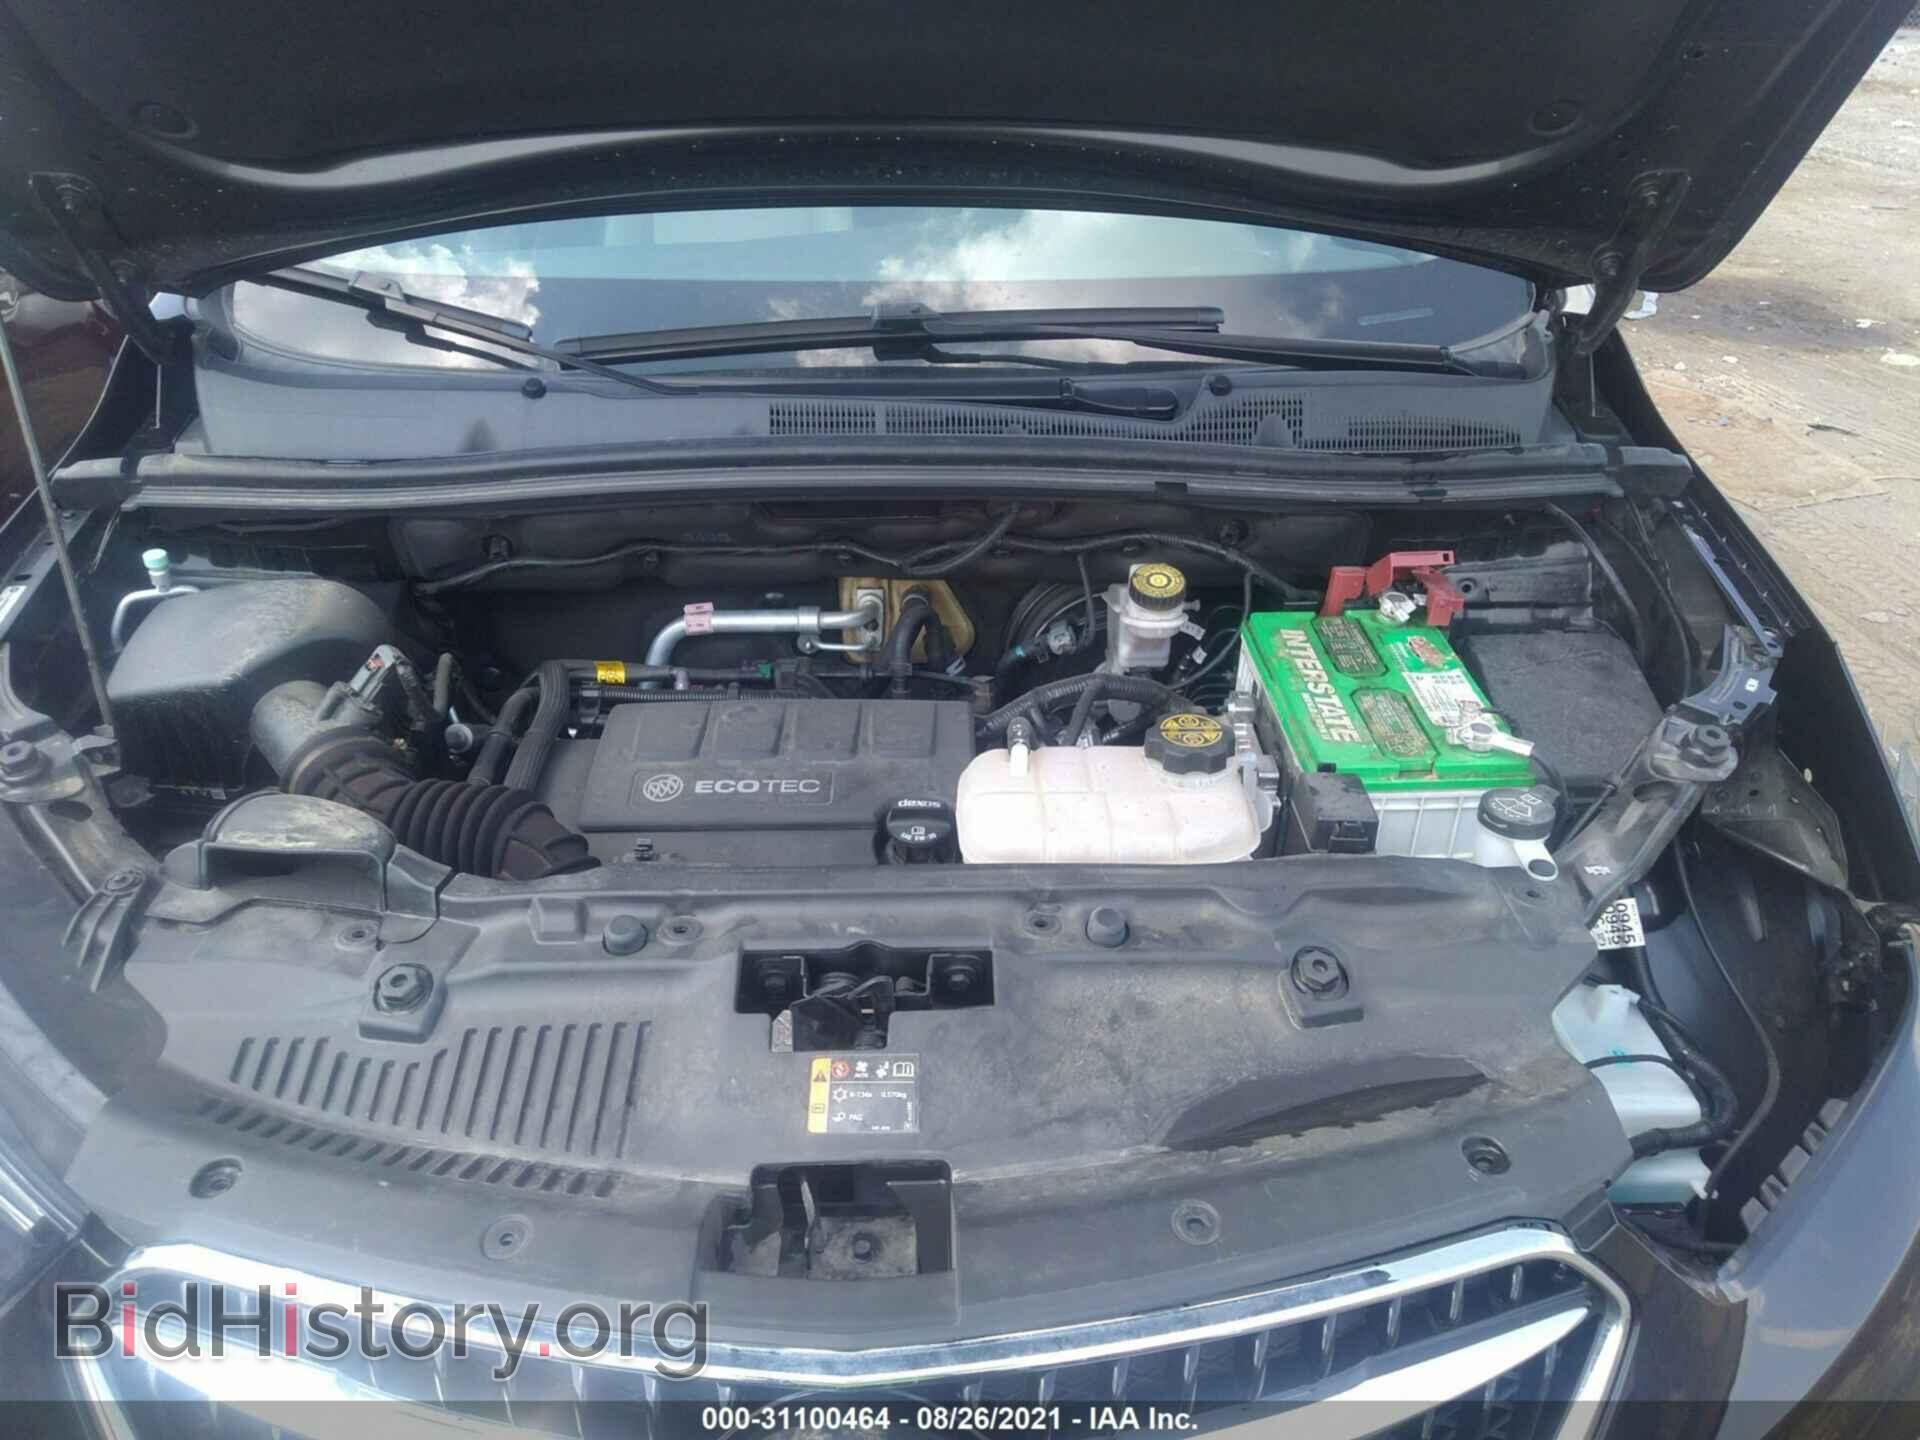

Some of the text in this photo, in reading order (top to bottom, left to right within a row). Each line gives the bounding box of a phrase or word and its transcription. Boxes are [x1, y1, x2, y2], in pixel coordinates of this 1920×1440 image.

[1279, 629, 1361, 744] INTERSTATE
[694, 779, 821, 795] ECOTEC
[897, 798, 941, 808] dexos
[1616, 903, 1636, 944] 0945
